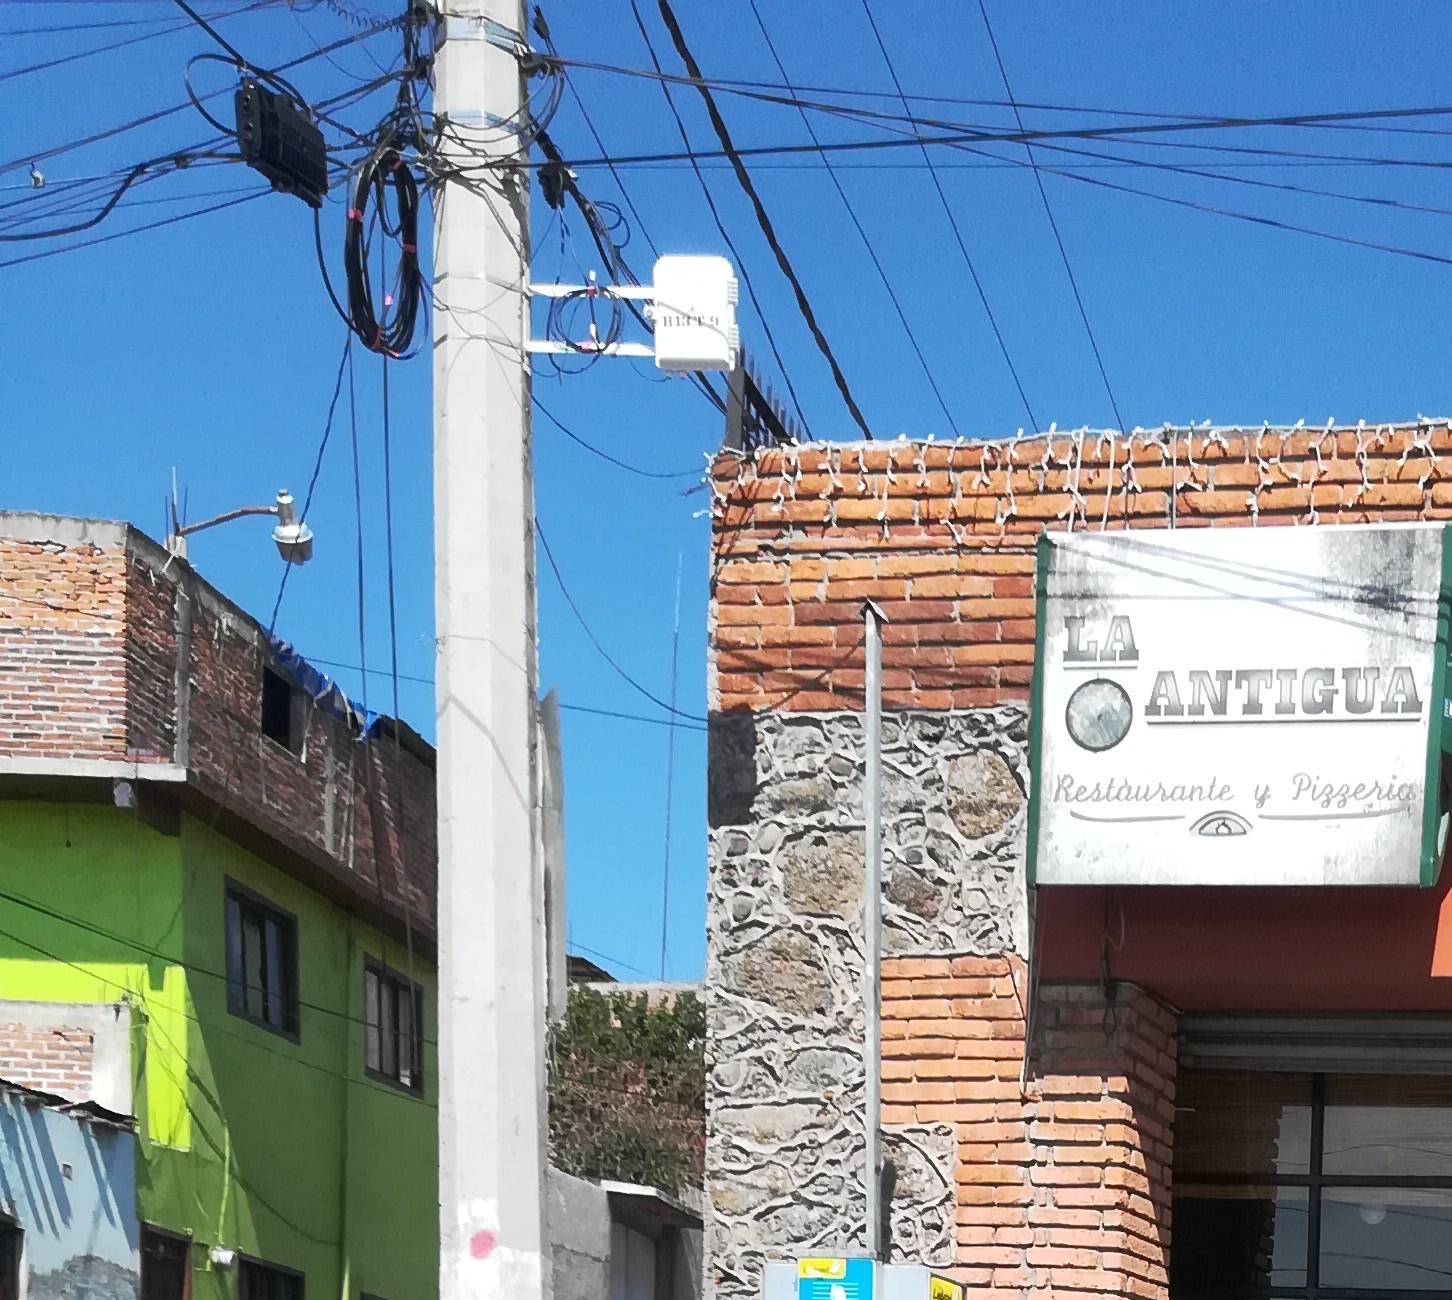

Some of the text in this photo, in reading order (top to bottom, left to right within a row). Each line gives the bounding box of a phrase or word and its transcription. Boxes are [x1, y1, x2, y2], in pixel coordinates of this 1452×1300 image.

[1062, 614, 1140, 662] LA
[1144, 666, 1423, 717] ANTIGUA
[1053, 771, 1417, 810] Restaurante y Pizzeria
